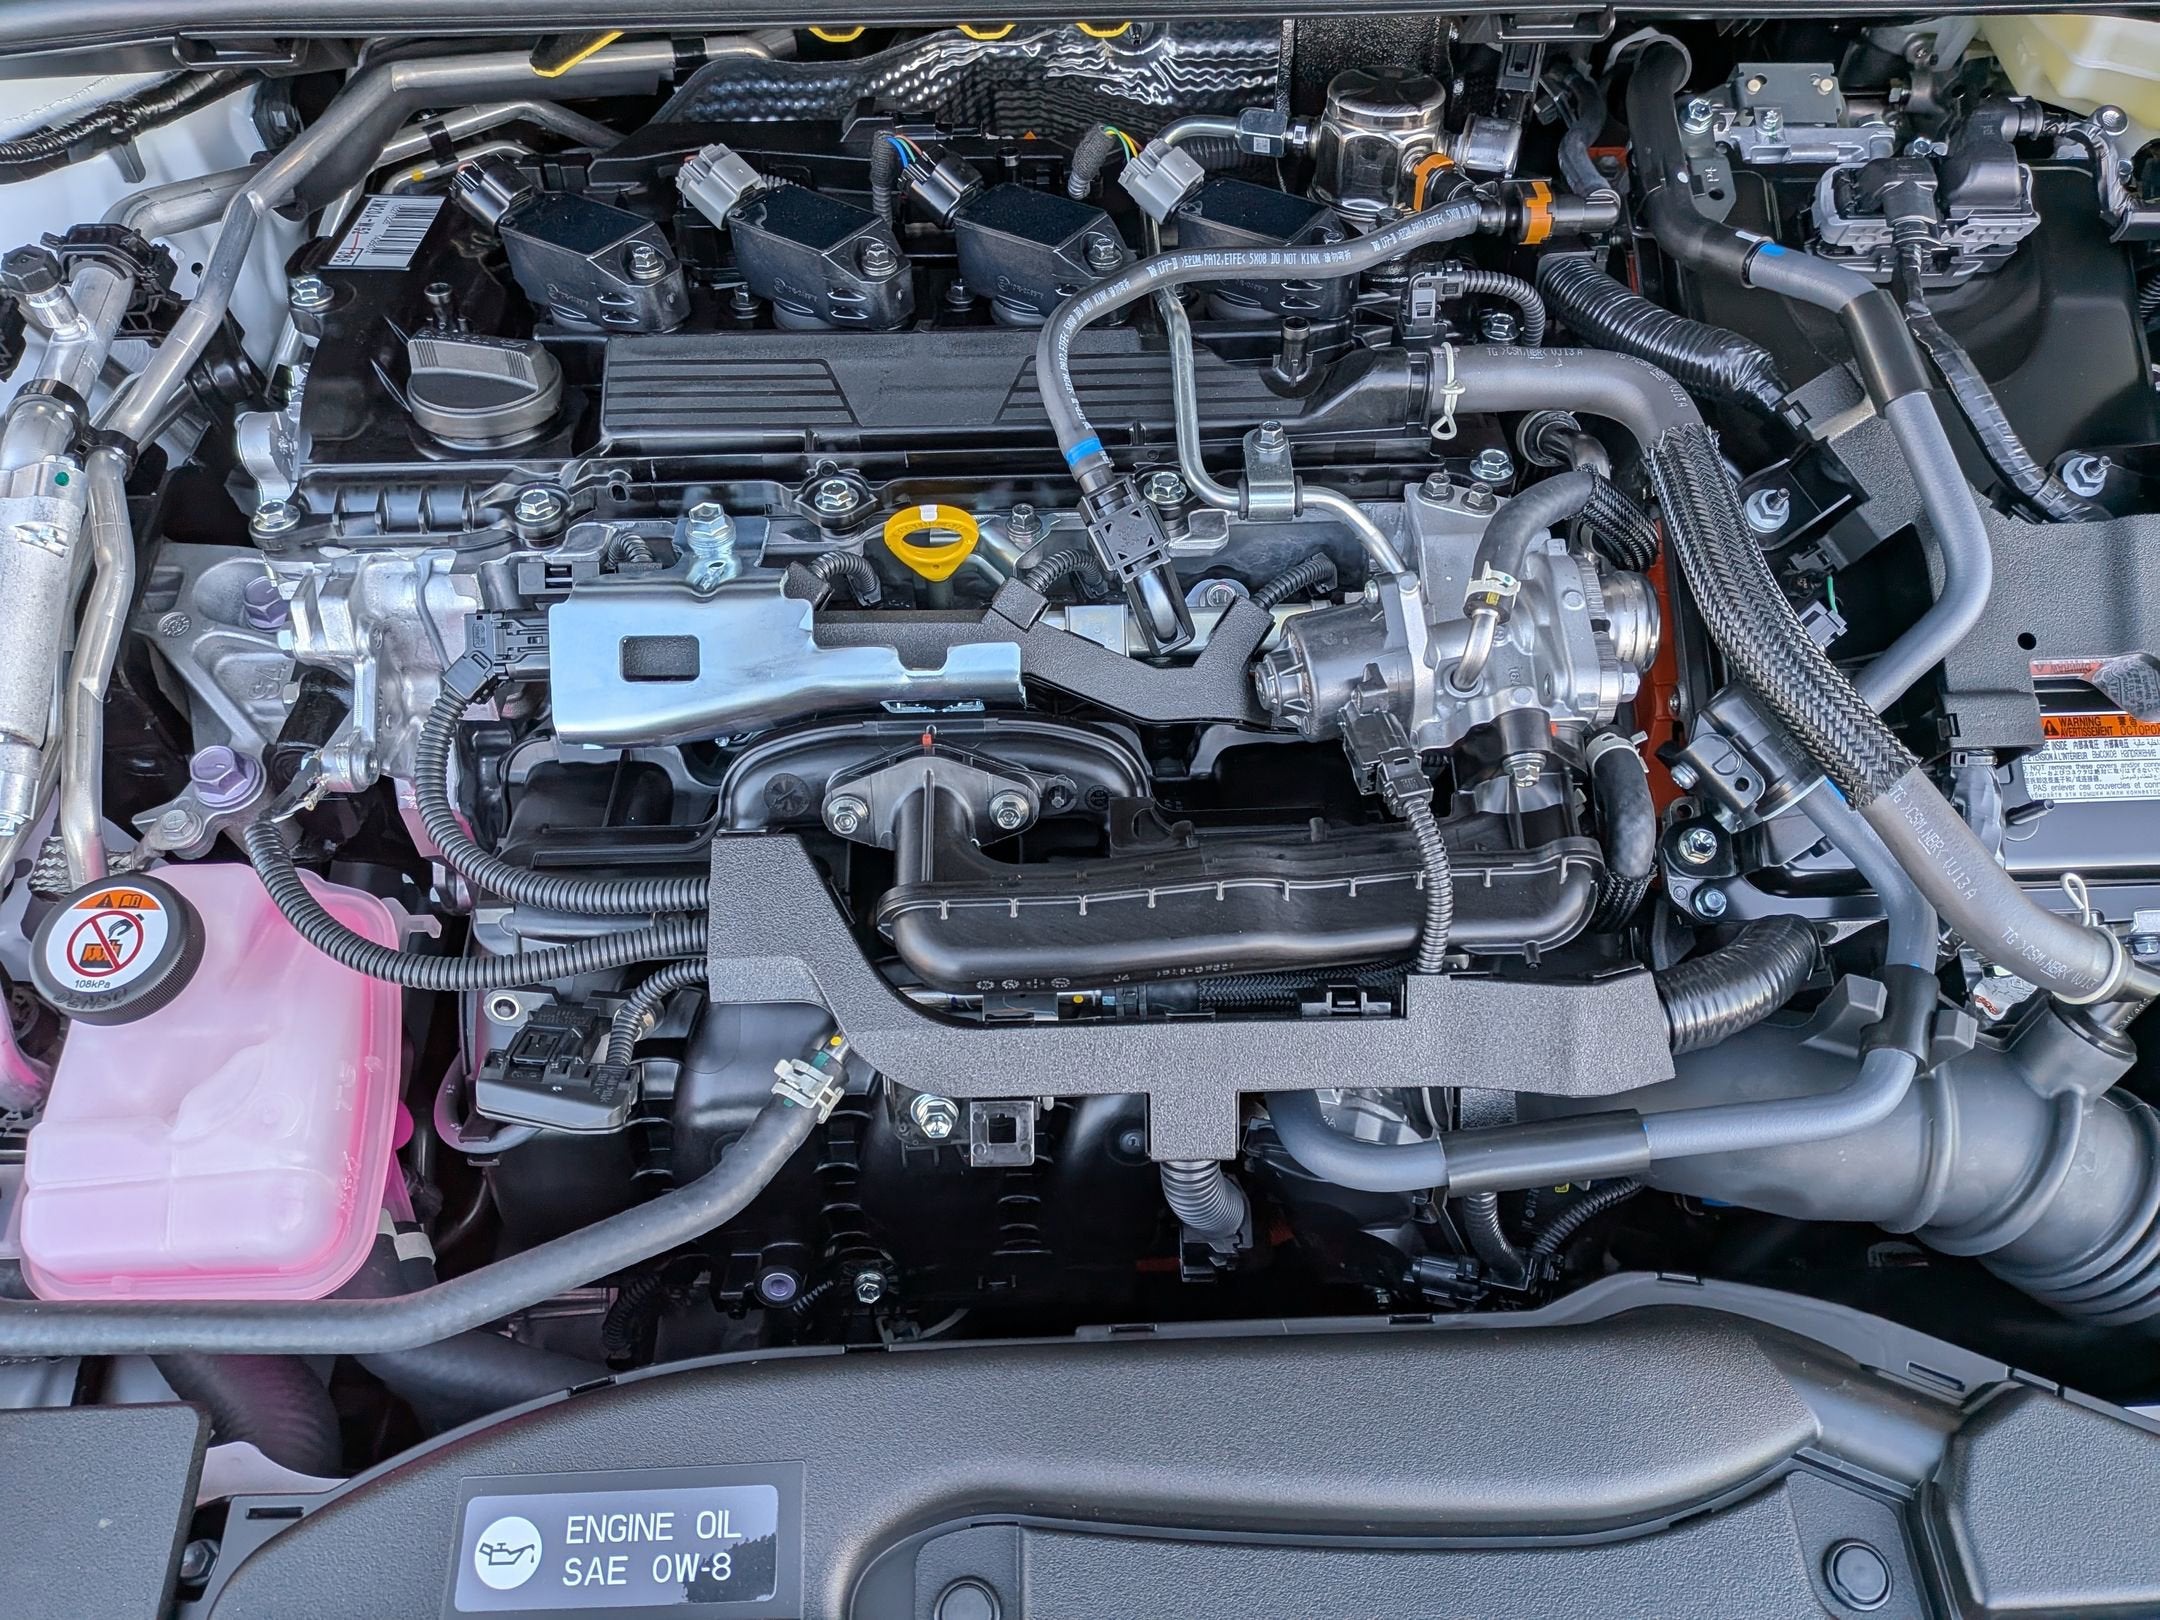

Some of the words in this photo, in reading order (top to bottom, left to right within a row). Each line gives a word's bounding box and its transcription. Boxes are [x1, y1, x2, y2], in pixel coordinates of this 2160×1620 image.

[1270, 252, 1281, 265] DO
[1283, 252, 1298, 265] NOT
[1301, 252, 1321, 265] KINK
[2058, 716, 2102, 727] WARNING
[2060, 725, 2113, 737] AVERTISSEMENT
[2033, 784, 2047, 792] PAS
[2050, 783, 2075, 791] enlever
[2095, 782, 2131, 790] couvercles
[1889, 784, 1908, 805] TG
[2001, 926, 2019, 945] TG
[74, 979, 111, 989] 108kPa
[565, 1511, 675, 1545] ENGINE
[696, 1509, 742, 1540] OIL
[562, 1555, 629, 1587] SAE
[652, 1551, 732, 1584] 0W-8
